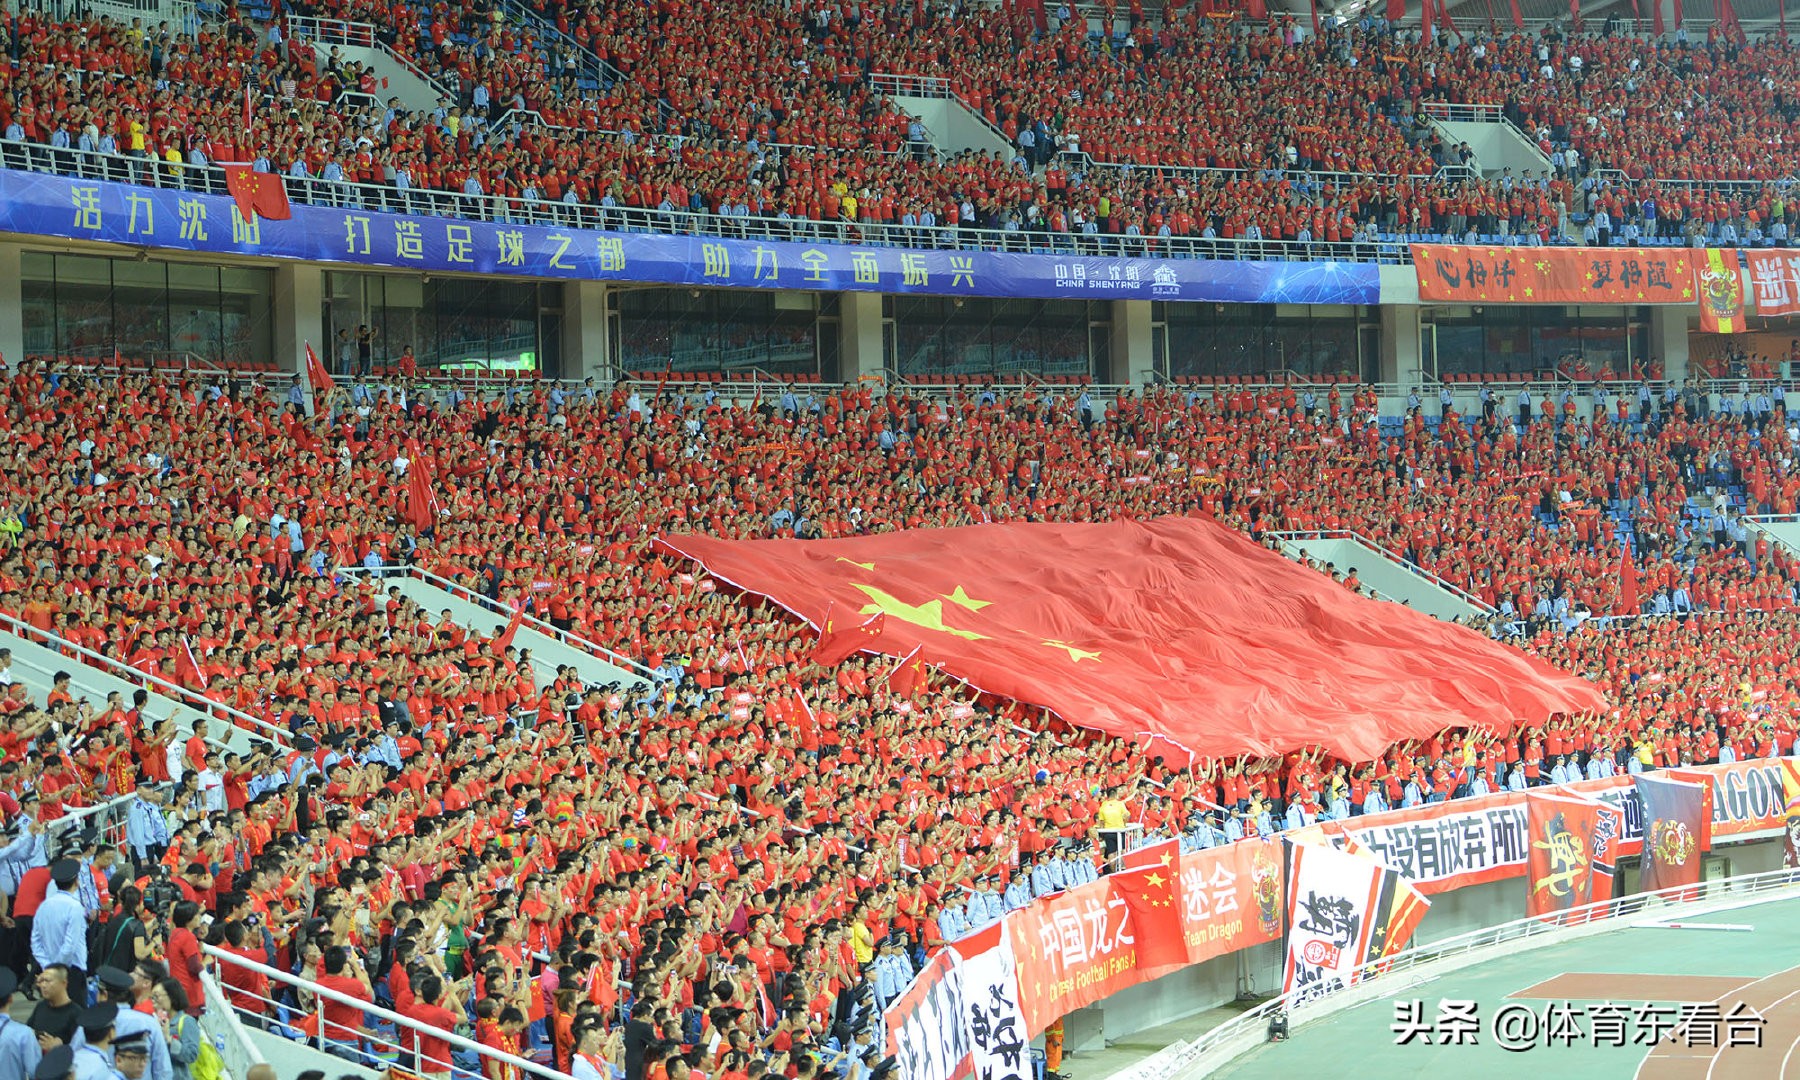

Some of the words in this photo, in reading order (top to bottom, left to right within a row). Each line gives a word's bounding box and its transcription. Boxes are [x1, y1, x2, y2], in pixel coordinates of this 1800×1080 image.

[71, 184, 261, 245] 活力沈阳
[343, 214, 626, 272] 打造足球之都
[702, 243, 975, 288] 助力全面振兴
[1055, 279, 1084, 288] CHINA
[1088, 280, 1141, 290] SHENYANG
[1434, 257, 1516, 289] 心相伴
[1712, 765, 1787, 823] AGON
[1331, 808, 1529, 880] 为没有放弃所
[1038, 890, 1135, 976] 中国龙之
[1076, 960, 1109, 990] Football
[1109, 955, 1130, 976] Fans
[1208, 919, 1243, 941] Dragon
